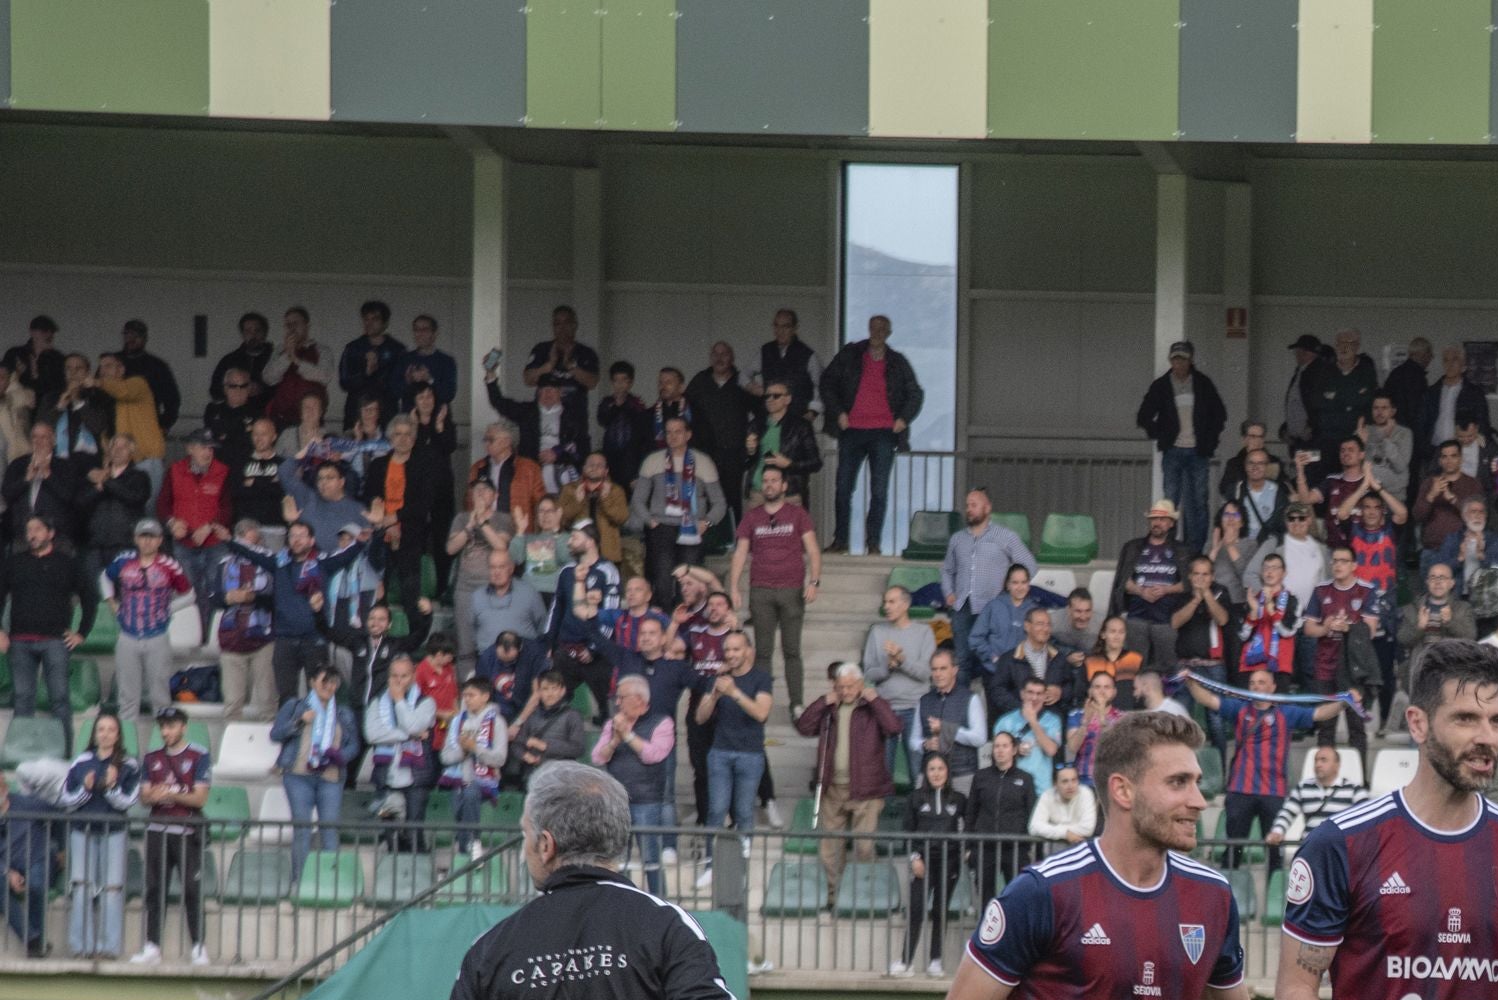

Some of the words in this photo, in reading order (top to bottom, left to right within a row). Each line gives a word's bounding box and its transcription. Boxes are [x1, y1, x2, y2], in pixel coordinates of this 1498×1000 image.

[1379, 886, 1411, 895] adidas
[1081, 936, 1111, 945] adidas
[1438, 933, 1471, 944] SEGOVIA
